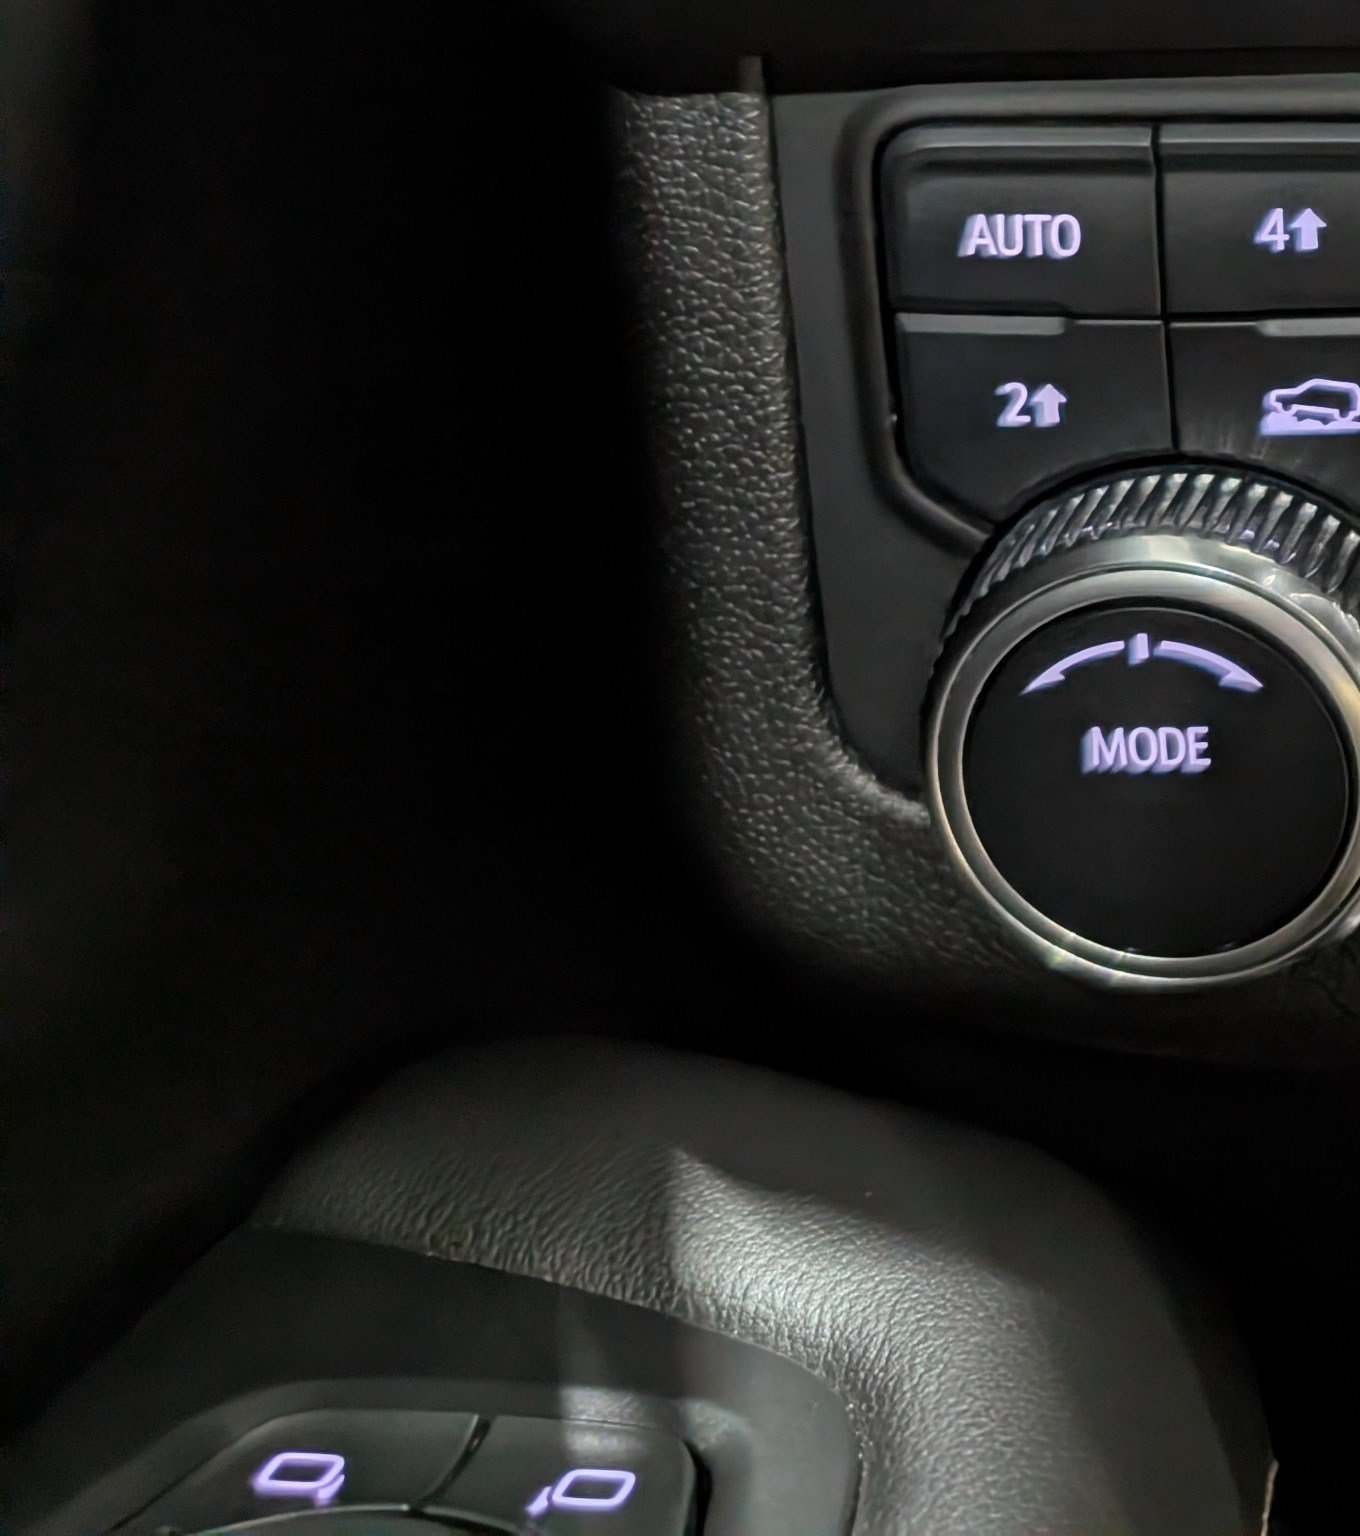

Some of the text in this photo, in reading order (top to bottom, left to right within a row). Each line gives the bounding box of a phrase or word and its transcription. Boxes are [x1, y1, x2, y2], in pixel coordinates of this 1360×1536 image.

[958, 213, 1081, 258] AUTO
[1255, 207, 1290, 252] 4
[995, 382, 1030, 427] 2
[1081, 726, 1212, 775] MODE
